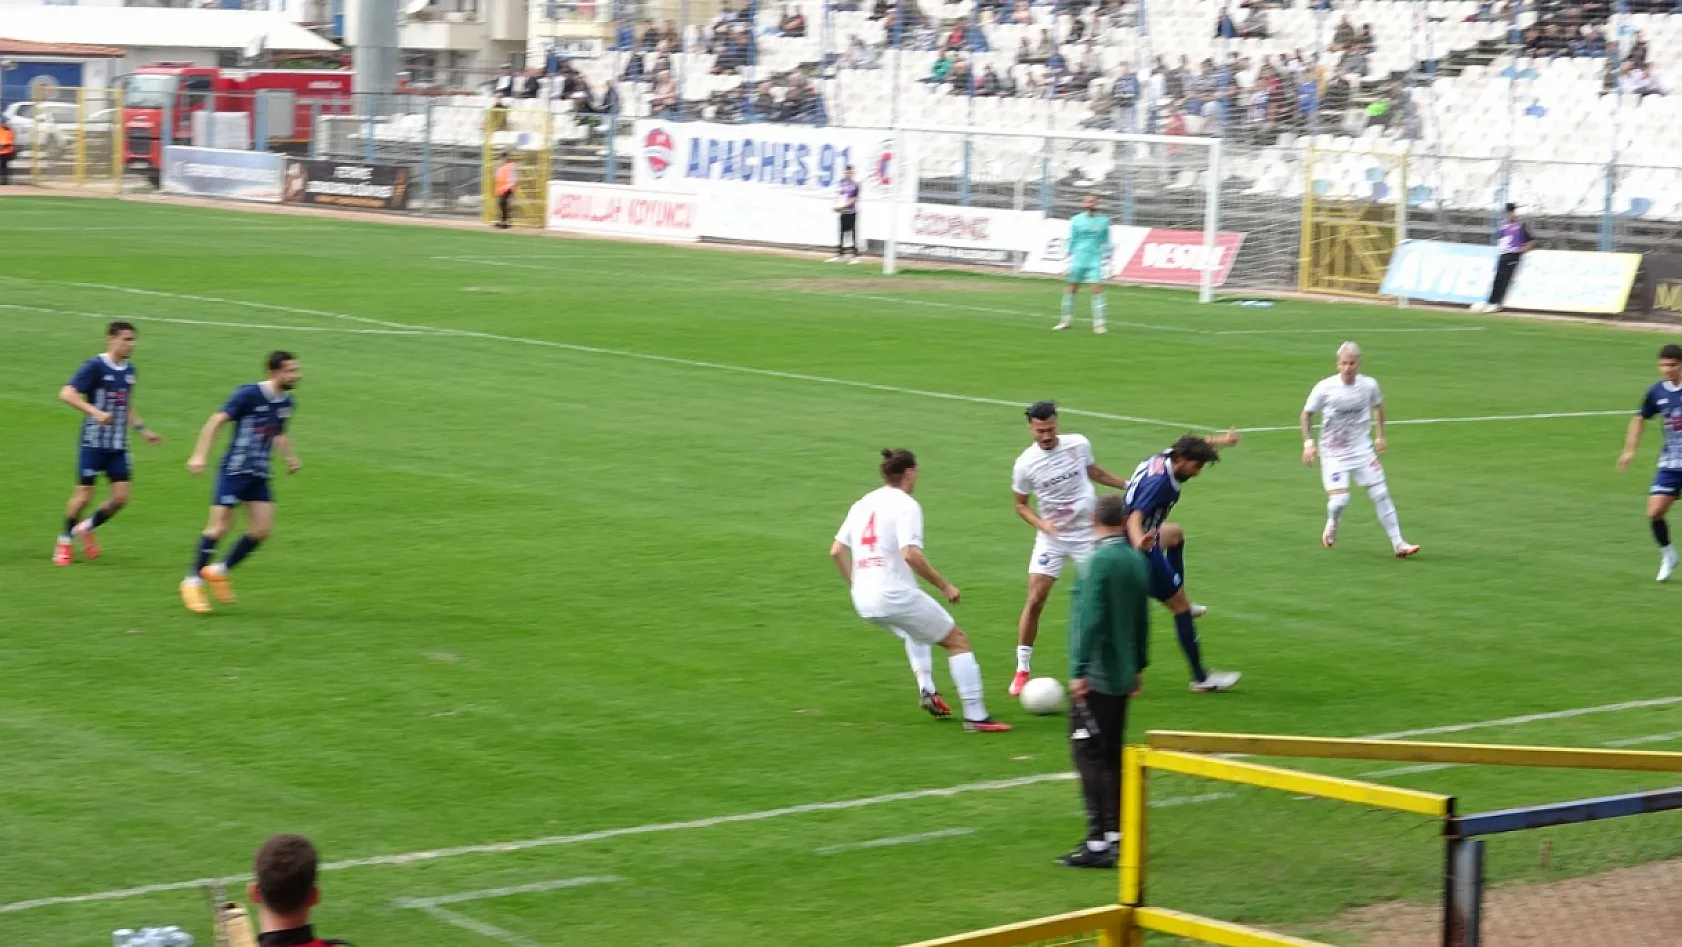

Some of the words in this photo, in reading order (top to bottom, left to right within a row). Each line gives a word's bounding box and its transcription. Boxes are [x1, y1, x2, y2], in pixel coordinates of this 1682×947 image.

[685, 138, 810, 186] APACHES
[818, 144, 851, 187] 91
[861, 511, 879, 552] 4
